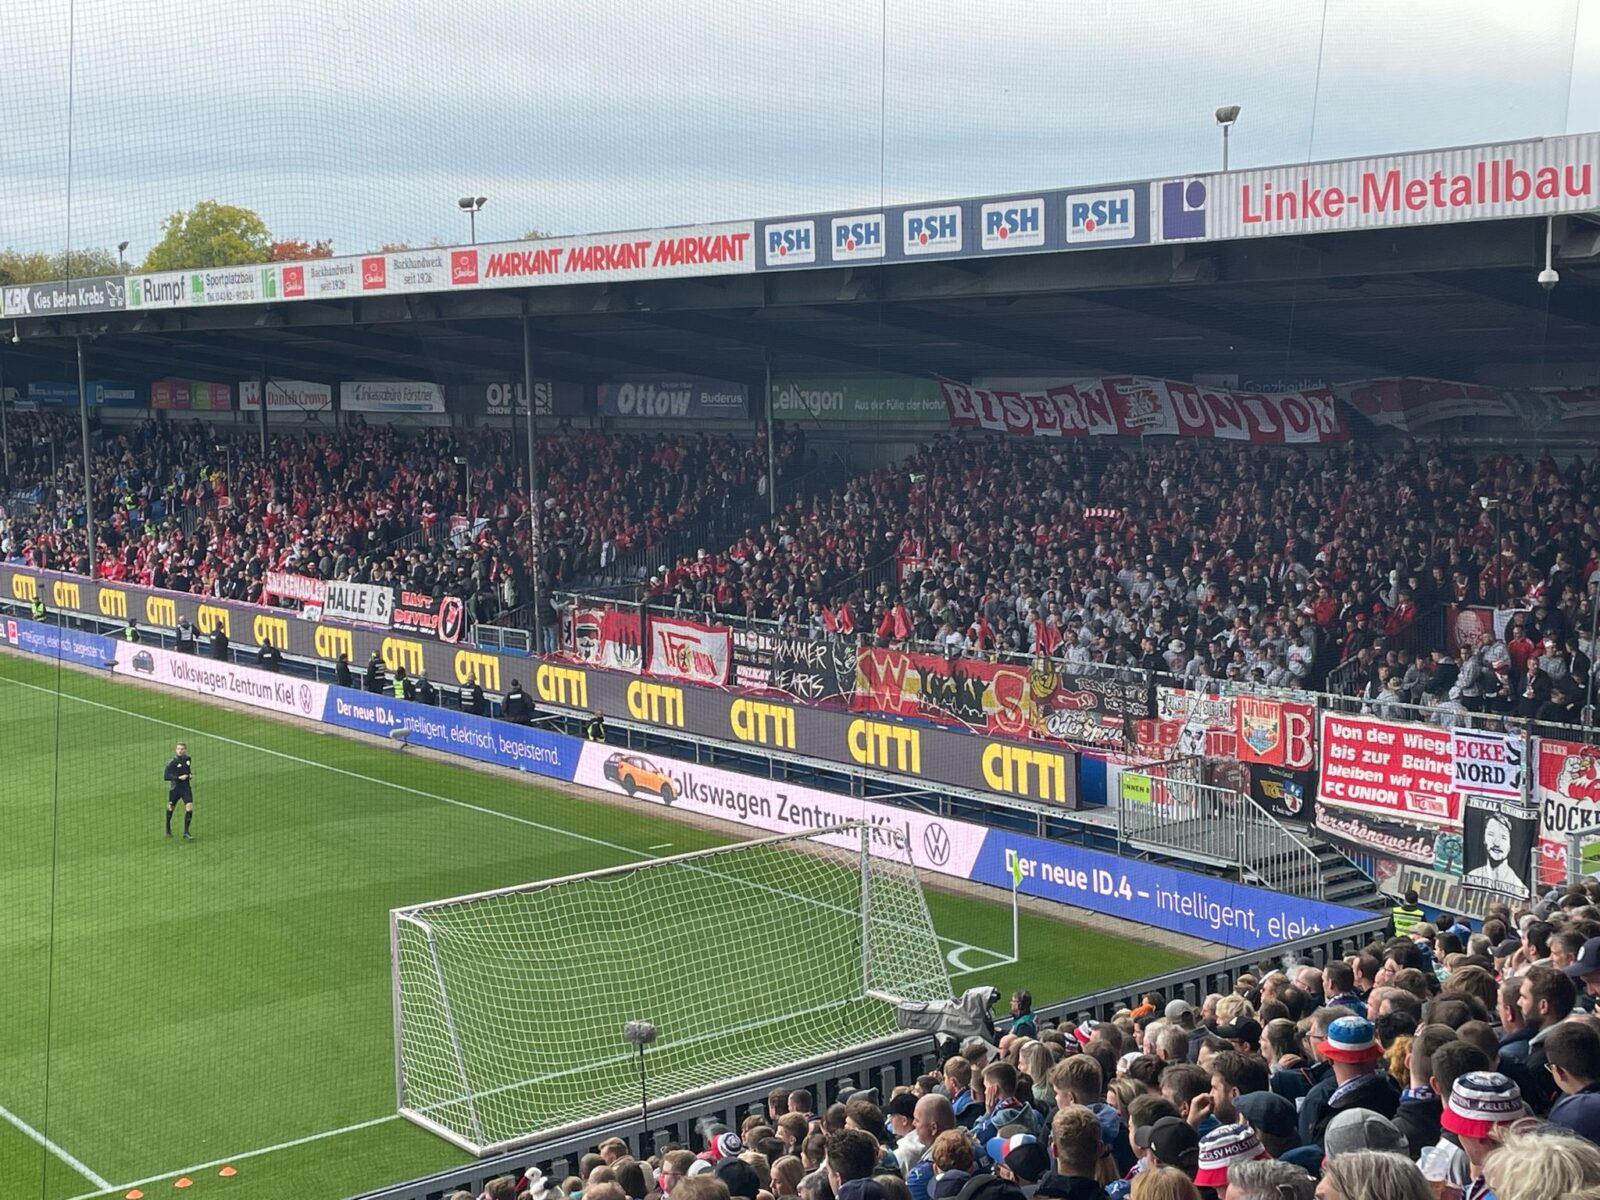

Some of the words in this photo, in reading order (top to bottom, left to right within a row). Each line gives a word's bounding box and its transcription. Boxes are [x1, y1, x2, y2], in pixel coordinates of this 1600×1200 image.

[1242, 159, 1592, 224] Linke-Metallbau
[987, 207, 1039, 235] RSH
[1072, 199, 1129, 228] RSH
[769, 229, 811, 253] RSH
[836, 222, 880, 247] RSH
[908, 215, 957, 245] RSH
[485, 249, 564, 278] MARKANT
[565, 241, 652, 272] MARKANT
[653, 233, 751, 267] MARKANT
[144, 276, 186, 304] Rumpf
[206, 272, 254, 289] Sportplatzbau
[33, 291, 51, 309] Kies
[53, 290, 77, 307] Beton
[79, 286, 105, 306] Krebs
[268, 391, 296, 405] Danish
[298, 392, 328, 405] Crown
[617, 383, 690, 416] Ottow
[701, 392, 743, 403] Buderus
[944, 383, 1113, 430] EISERN
[1170, 390, 1335, 434] UNION
[12, 573, 36, 600] CITTI
[53, 580, 80, 609] CITTI
[98, 587, 127, 617] CITTI
[327, 586, 366, 613] HALLE
[146, 595, 176, 626] CITTI
[197, 604, 230, 637] CITTI
[253, 615, 288, 649] CITTI
[315, 625, 353, 662] CITTI
[382, 637, 423, 674] CITTI
[454, 651, 500, 691] CITTI
[170, 658, 227, 692] Volkswagen
[229, 671, 273, 700] Zentrum
[275, 684, 295, 707] Kiel
[537, 664, 588, 708] CITTI
[627, 680, 684, 727] CITTI
[336, 698, 352, 715] Der
[352, 705, 374, 721] neue
[375, 708, 395, 725] ID.4
[404, 717, 449, 742] intelligent,
[450, 724, 497, 752] elektrisch,
[500, 735, 561, 766] begeisternd.
[730, 698, 796, 749] CITTI
[1047, 715, 1082, 735] Oder
[1083, 718, 1124, 742] Spree
[1331, 722, 1362, 741] Von
[1366, 727, 1396, 746] der
[847, 719, 921, 774] CITTI
[1285, 712, 1313, 767] B
[1456, 739, 1506, 763] ECKE
[982, 743, 1066, 802] CITTI
[1330, 743, 1356, 761] bis
[1362, 749, 1391, 765] zur
[1402, 754, 1454, 775] Bahre
[1455, 762, 1506, 784] NORD
[1325, 782, 1345, 796] FC
[1348, 784, 1399, 805] UNION
[1327, 763, 1383, 783] bleiben
[1390, 773, 1413, 788] wir
[1419, 777, 1453, 795] treu
[659, 767, 771, 819] olkswagen
[871, 815, 911, 850] Kiel
[1004, 848, 1036, 877] Der
[1041, 863, 1087, 889] neue
[1093, 868, 1132, 900] ID.4
[1156, 884, 1260, 938] intelligent,
[1478, 1101, 1510, 1111] KIELER
[1213, 1149, 1223, 1159] SV
